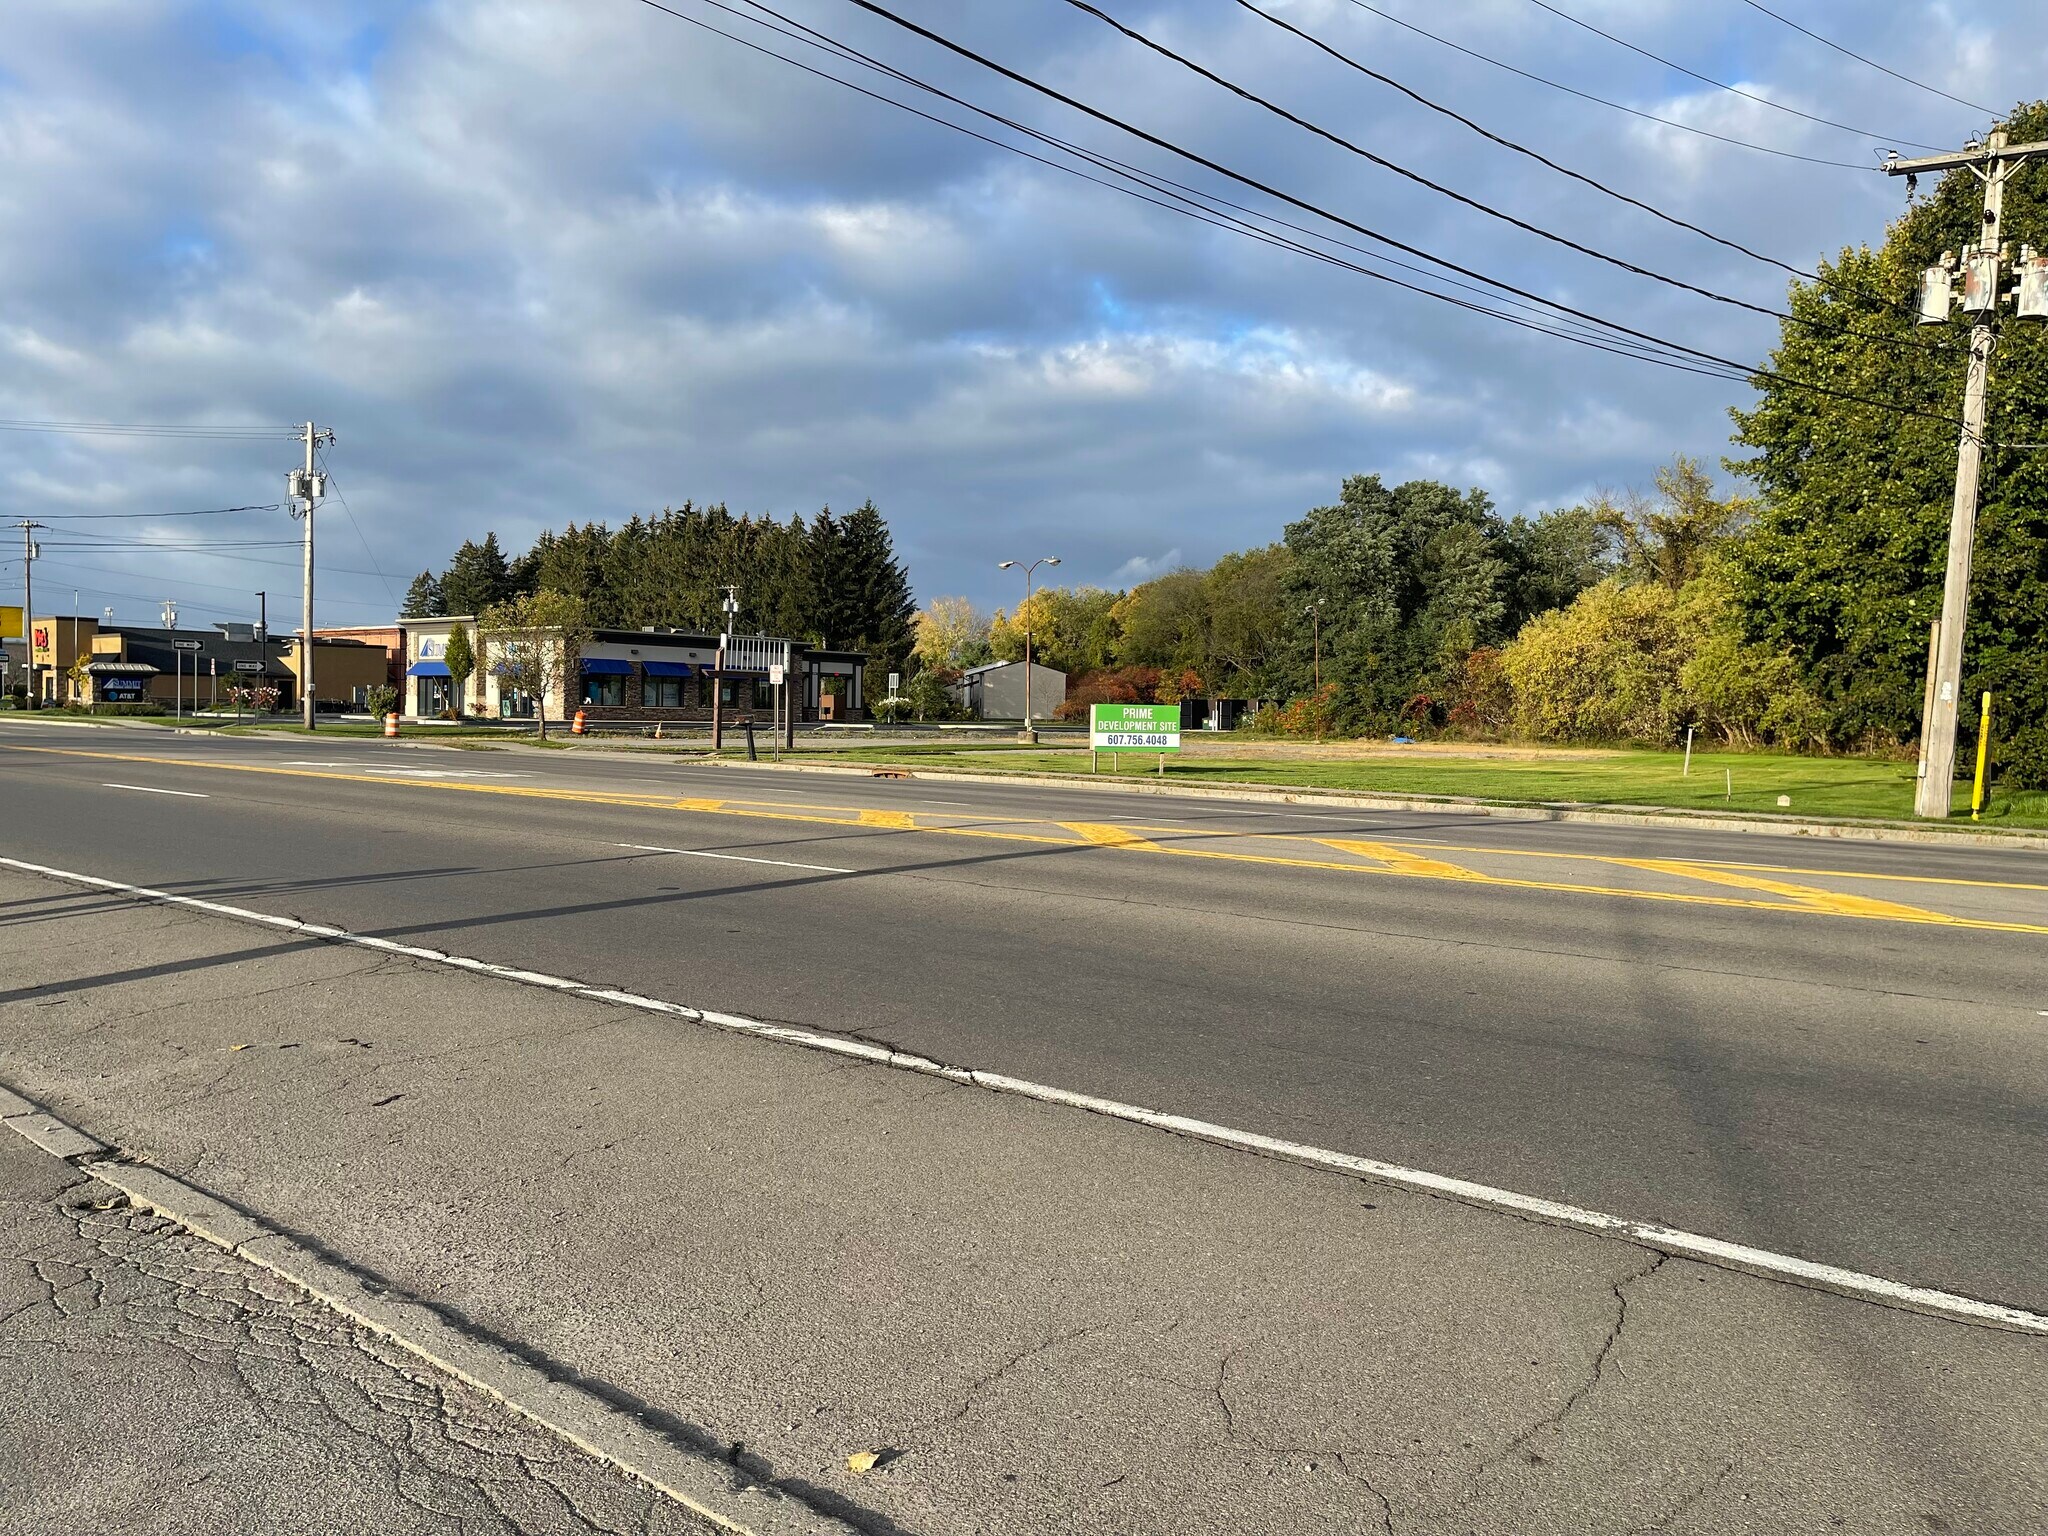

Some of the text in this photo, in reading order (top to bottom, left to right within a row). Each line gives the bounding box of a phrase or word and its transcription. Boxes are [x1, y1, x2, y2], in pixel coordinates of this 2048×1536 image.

[113, 678, 142, 687] SUMMIT
[1123, 708, 1153, 719] PRIME
[1098, 720, 1177, 732] DEVELOPMENT SITE
[1107, 734, 1168, 746] 607.756.4048
